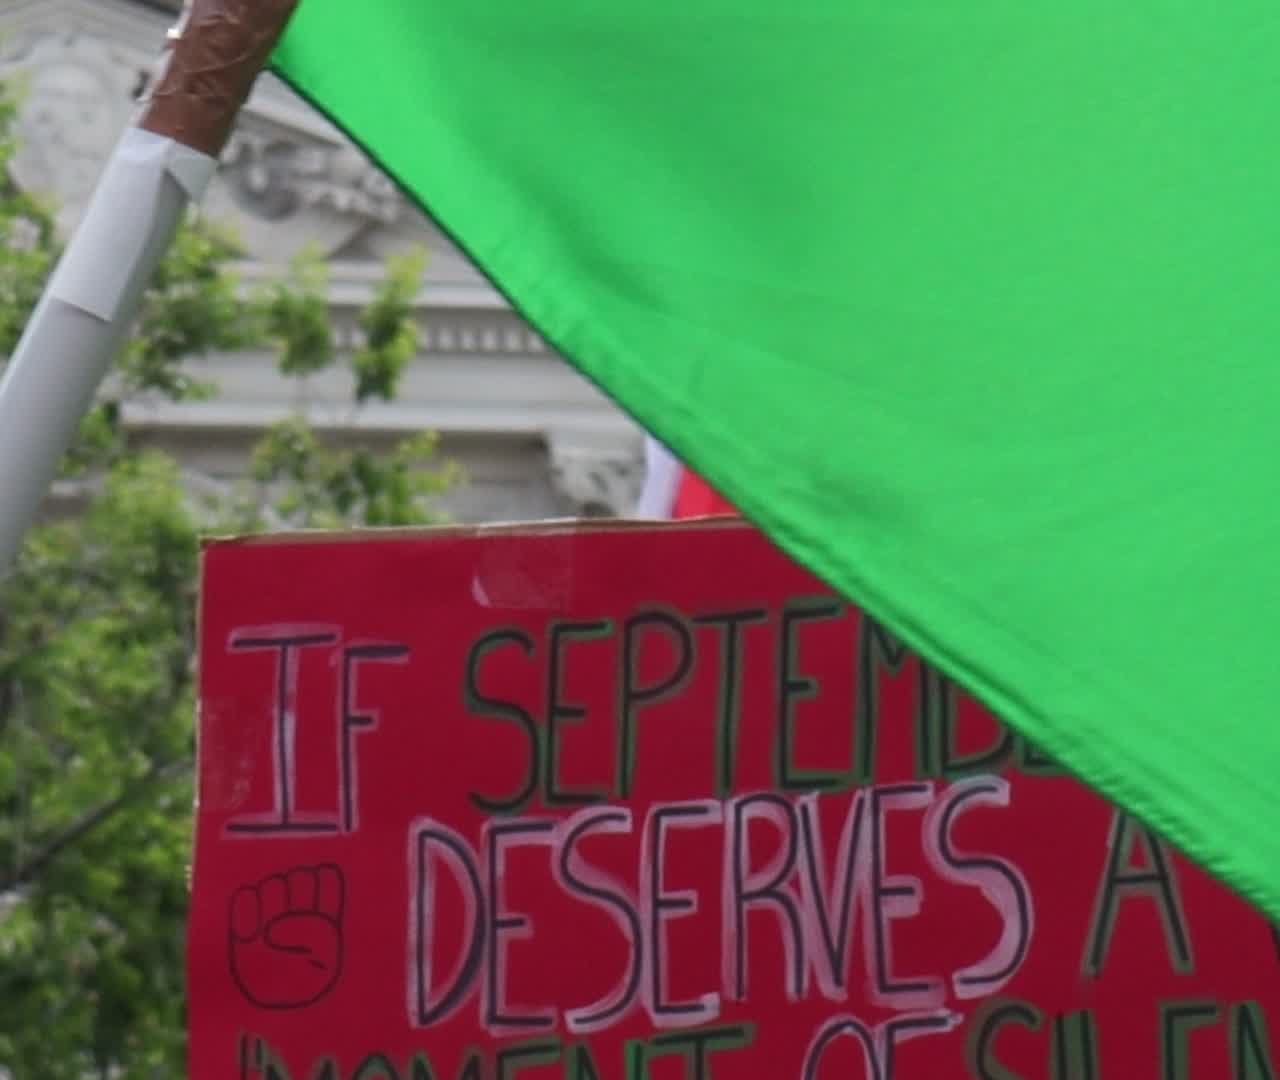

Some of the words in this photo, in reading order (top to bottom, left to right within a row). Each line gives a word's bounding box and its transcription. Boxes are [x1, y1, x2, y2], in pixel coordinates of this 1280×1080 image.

[226, 622, 409, 838] IF
[407, 774, 1036, 1033] DESERVES
[1080, 805, 1196, 978] A
